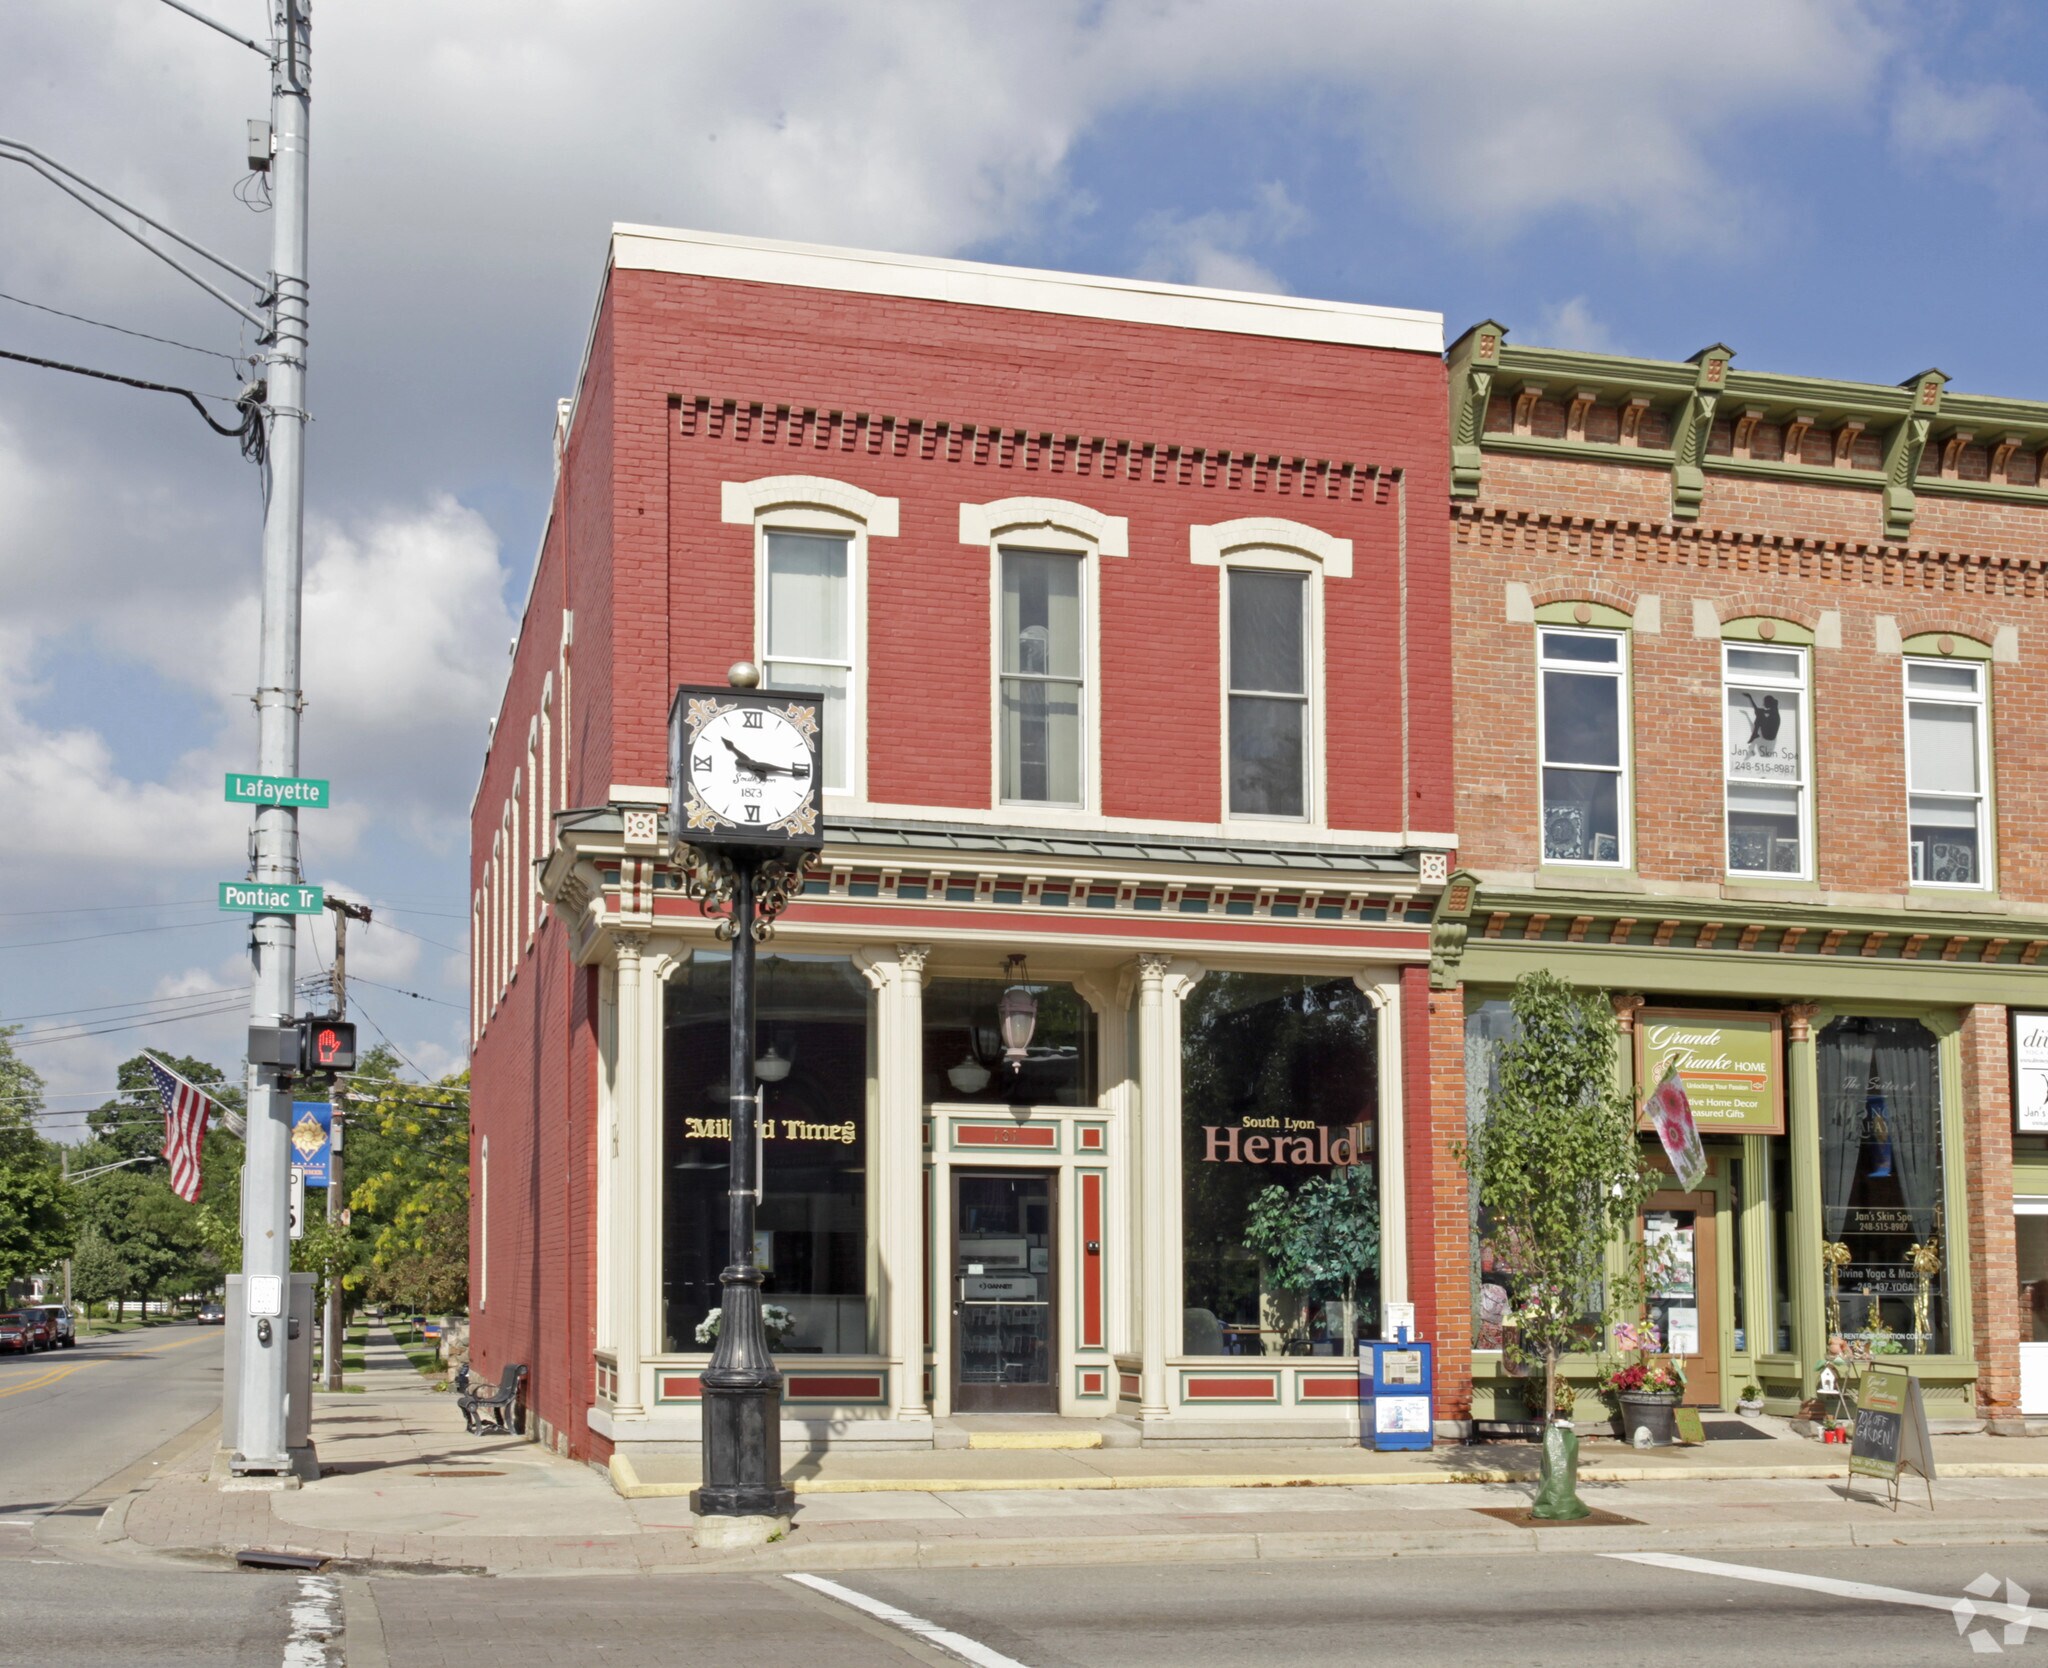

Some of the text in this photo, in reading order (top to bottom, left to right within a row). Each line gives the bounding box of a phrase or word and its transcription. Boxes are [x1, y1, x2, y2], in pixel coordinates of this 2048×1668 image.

[742, 711, 763, 728] XII
[1782, 747, 1799, 761] Spa
[1735, 761, 1795, 774] 248-515-8987
[236, 777, 320, 803] Lafayette
[741, 788, 762, 798] 1873
[744, 804, 761, 822] VI
[226, 886, 315, 908] Pontiac Tr
[1647, 1024, 1721, 1050] Grande
[1662, 1046, 1767, 1073] Trunke HOME
[1686, 1082, 1714, 1091] Unlocking
[1728, 1083, 1749, 1091] Passion
[1841, 1076, 1861, 1090] The
[1865, 1077, 1899, 1091] Suites
[1688, 1098, 1758, 1108] tive Home Decor
[1691, 1109, 1745, 1119] easured Gifts
[2024, 1105, 2046, 1117] Jan's
[1242, 1115, 1315, 1132] South Lyon
[781, 1120, 857, 1145] Times
[1201, 1125, 1361, 1166] Herald
[1855, 1211, 1913, 1223] Jan's Skin Spa
[1860, 1222, 1908, 1231] 248-515-8987
[1837, 1268, 1863, 1278] Divine
[1865, 1268, 1886, 1280] Yoga
[1888, 1268, 1896, 1278] &
